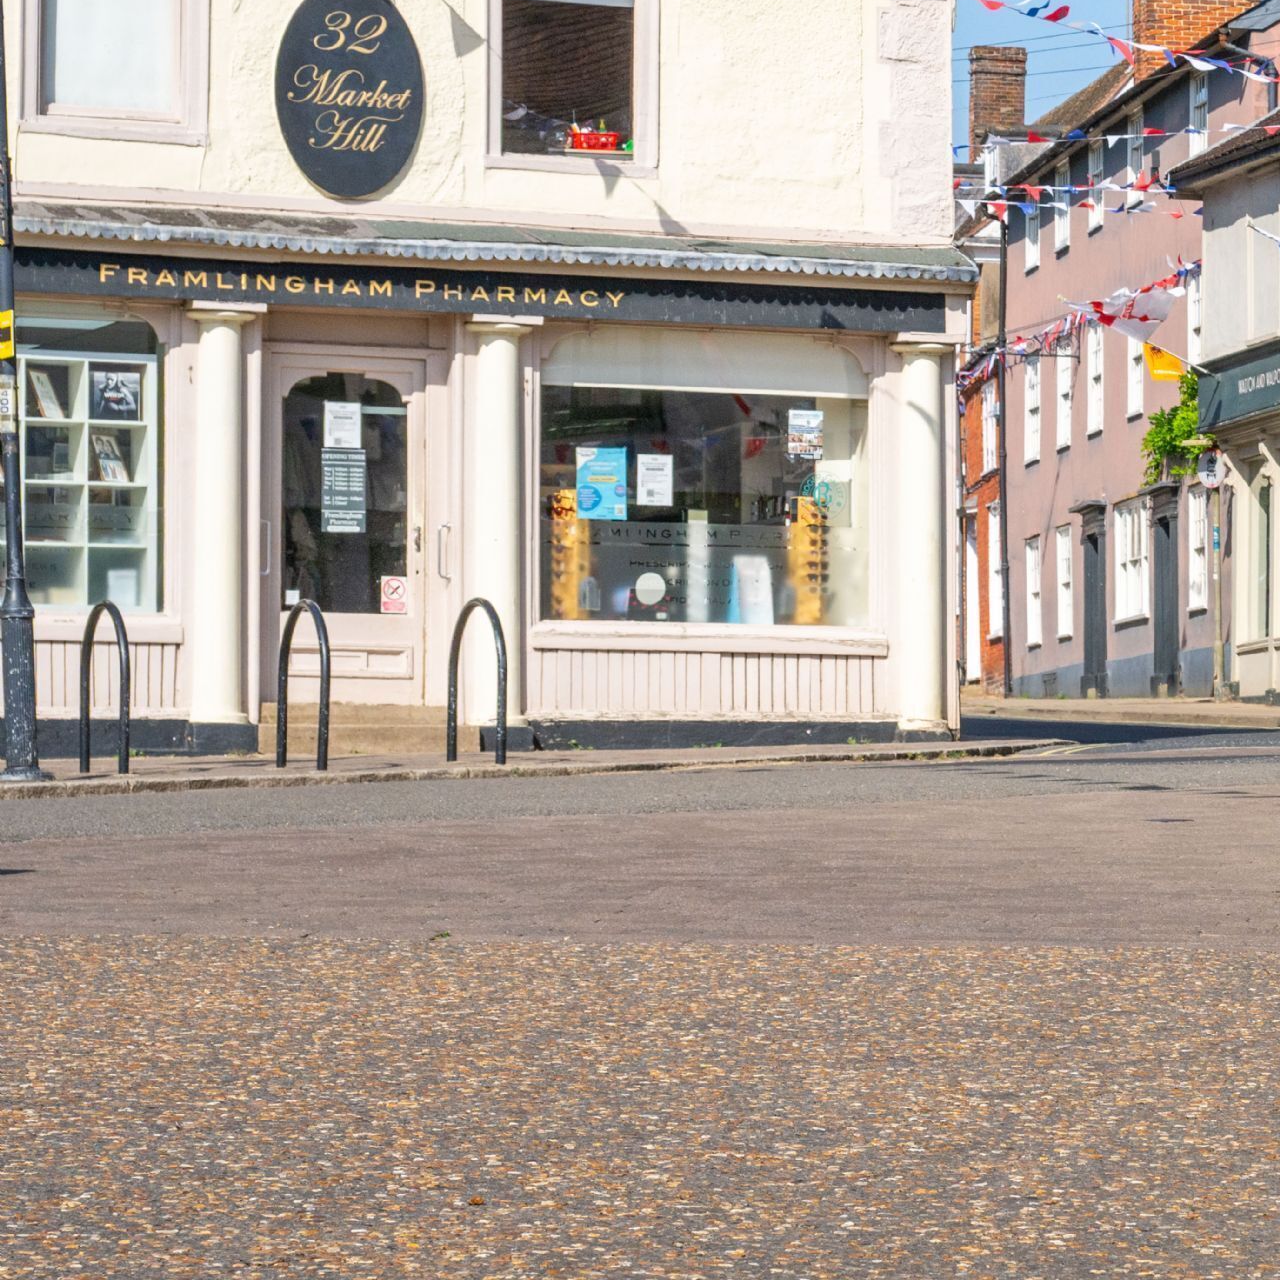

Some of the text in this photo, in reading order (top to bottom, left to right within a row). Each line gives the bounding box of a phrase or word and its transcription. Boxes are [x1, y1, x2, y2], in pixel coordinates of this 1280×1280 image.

[313, 10, 388, 55] 32
[287, 63, 412, 110] Market
[308, 109, 405, 153] Hill
[99, 263, 625, 308] FRAMLINGHAM PHARMACY
